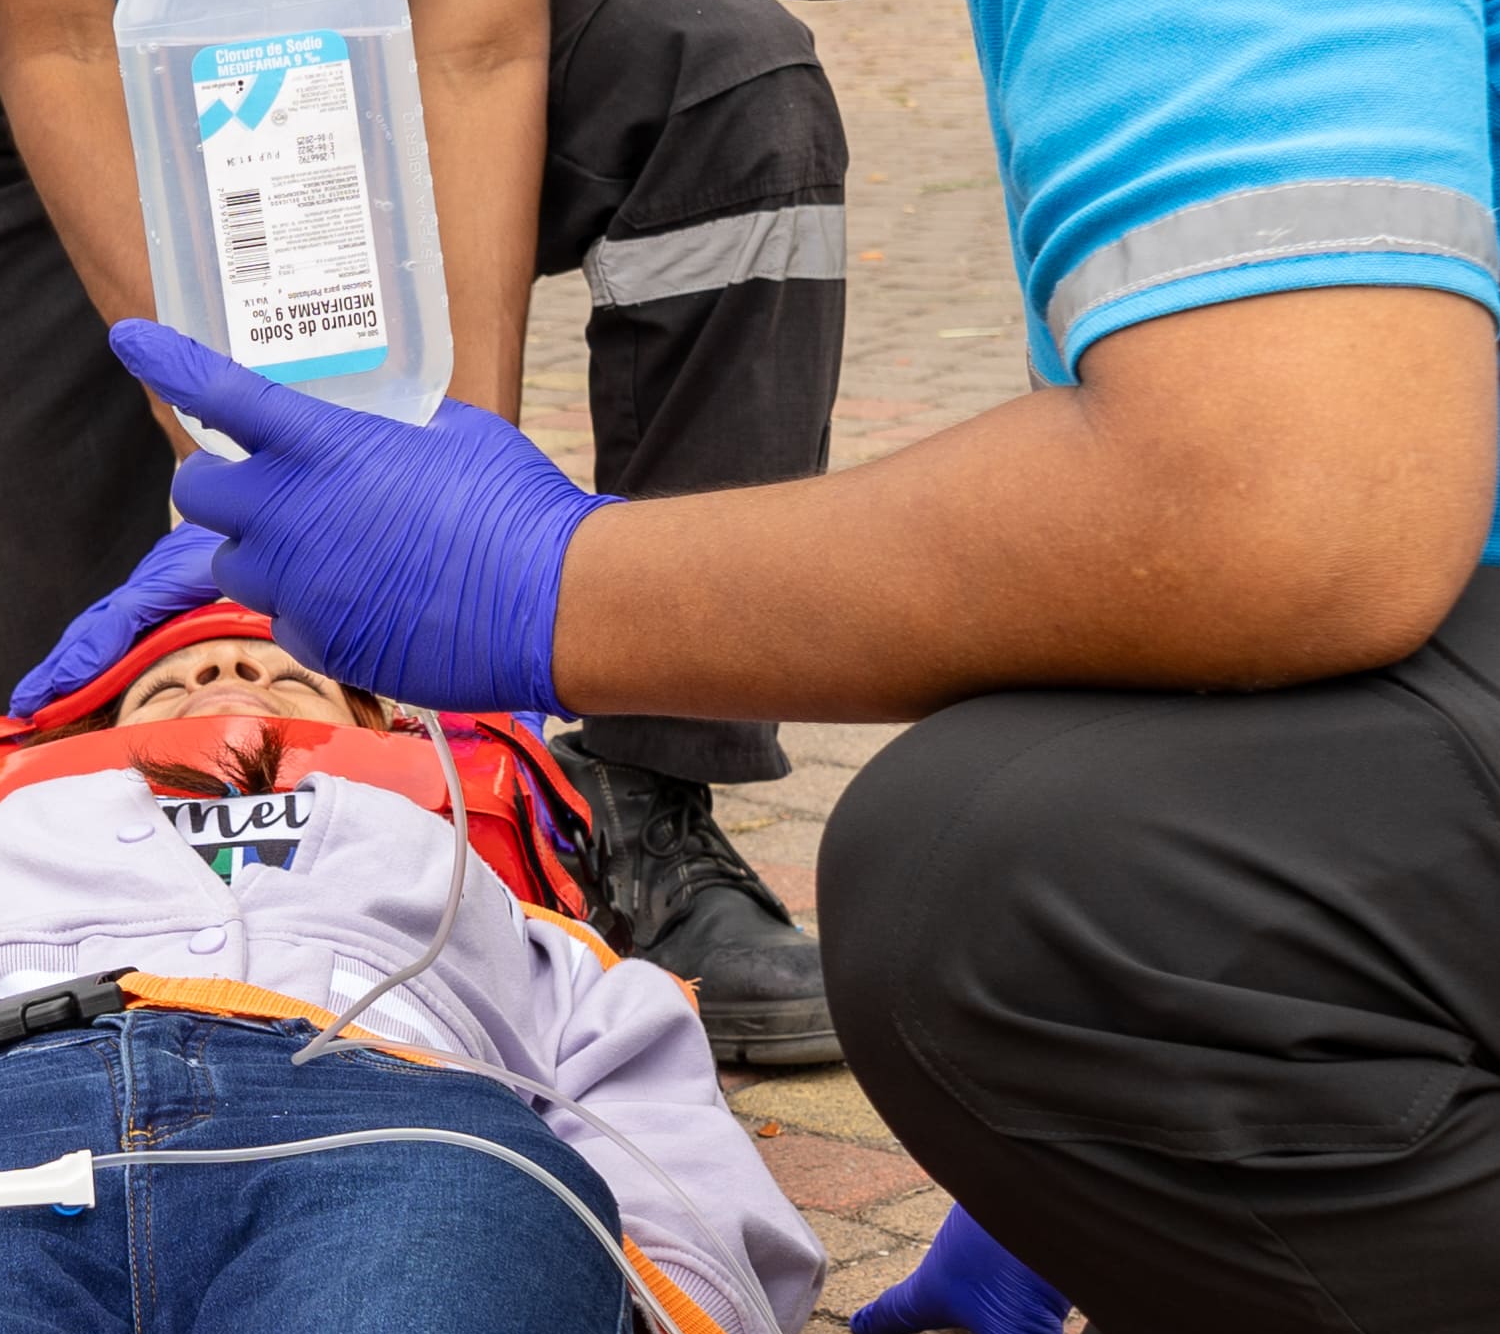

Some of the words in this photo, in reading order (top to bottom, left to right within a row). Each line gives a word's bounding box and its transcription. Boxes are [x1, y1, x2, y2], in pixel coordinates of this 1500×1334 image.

[215, 47, 263, 65] Cloruro
[266, 42, 282, 57] de
[286, 35, 323, 53] Sodio
[217, 55, 292, 77] MEDIFARMA
[294, 54, 302, 67] 9
[275, 307, 284, 322] 9
[288, 292, 375, 319] MEDIFARMA
[298, 319, 317, 337] de
[321, 309, 377, 331] Cloruro
[250, 323, 293, 345] Sodio
